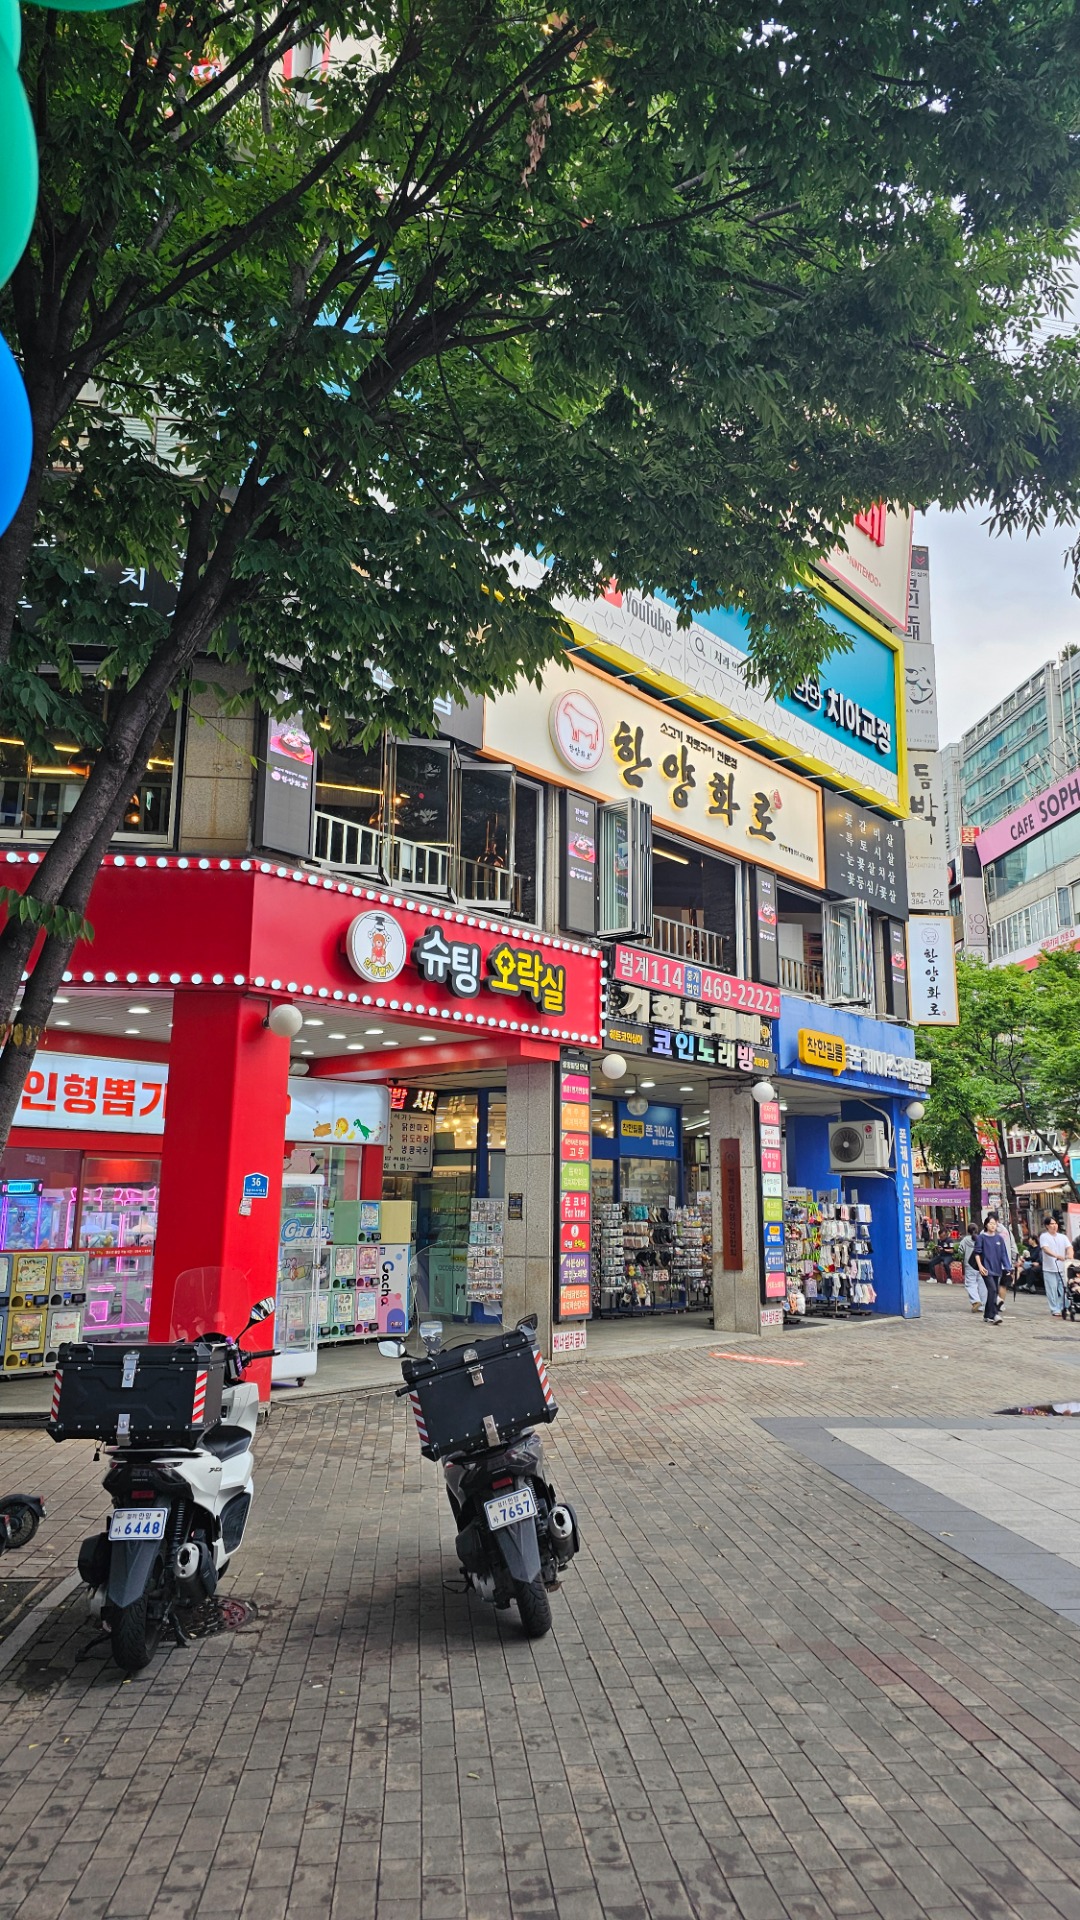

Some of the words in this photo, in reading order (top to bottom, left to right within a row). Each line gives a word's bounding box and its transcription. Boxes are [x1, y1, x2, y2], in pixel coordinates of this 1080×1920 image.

[626, 590, 672, 637] YouTube
[714, 650, 730, 670] 치과
[827, 688, 891, 754] 치아교정
[660, 722, 683, 743] 소고기
[686, 734, 715, 759] 화로구이
[717, 750, 738, 770] 전문점
[613, 720, 777, 842] 한양화로
[1010, 813, 1035, 841] CAFE
[1038, 778, 1080, 823] SOPH
[910, 899, 946, 907] 384-1706
[932, 888, 945, 899] 2F
[969, 914, 985, 925] SO
[969, 924, 986, 935] YO
[363, 957, 395, 977] 인형뽑기
[419, 929, 480, 994] 슈팅
[491, 946, 565, 1012] 오락실
[686, 970, 700, 984] 중개
[619, 951, 684, 992] 범계114
[703, 975, 773, 1014] 469-2222
[686, 983, 700, 996] 법인
[924, 948, 941, 1017] 한양화로
[651, 1029, 755, 1072] 코인노래방
[806, 1036, 843, 1063] 착한필름
[622, 1123, 643, 1134] 착한필름
[645, 1124, 675, 1138] 폰케이스
[251, 1177, 261, 1187] 36
[899, 1127, 914, 1250] 폰케이스전문점
[381, 1260, 395, 1307] Gacha
[553, 1332, 585, 1351] 배너설치금지
[507, 1496, 519, 1505] 안양
[138, 1512, 152, 1520] 안양
[500, 1500, 530, 1522] 7657
[124, 1521, 160, 1535] 6448
